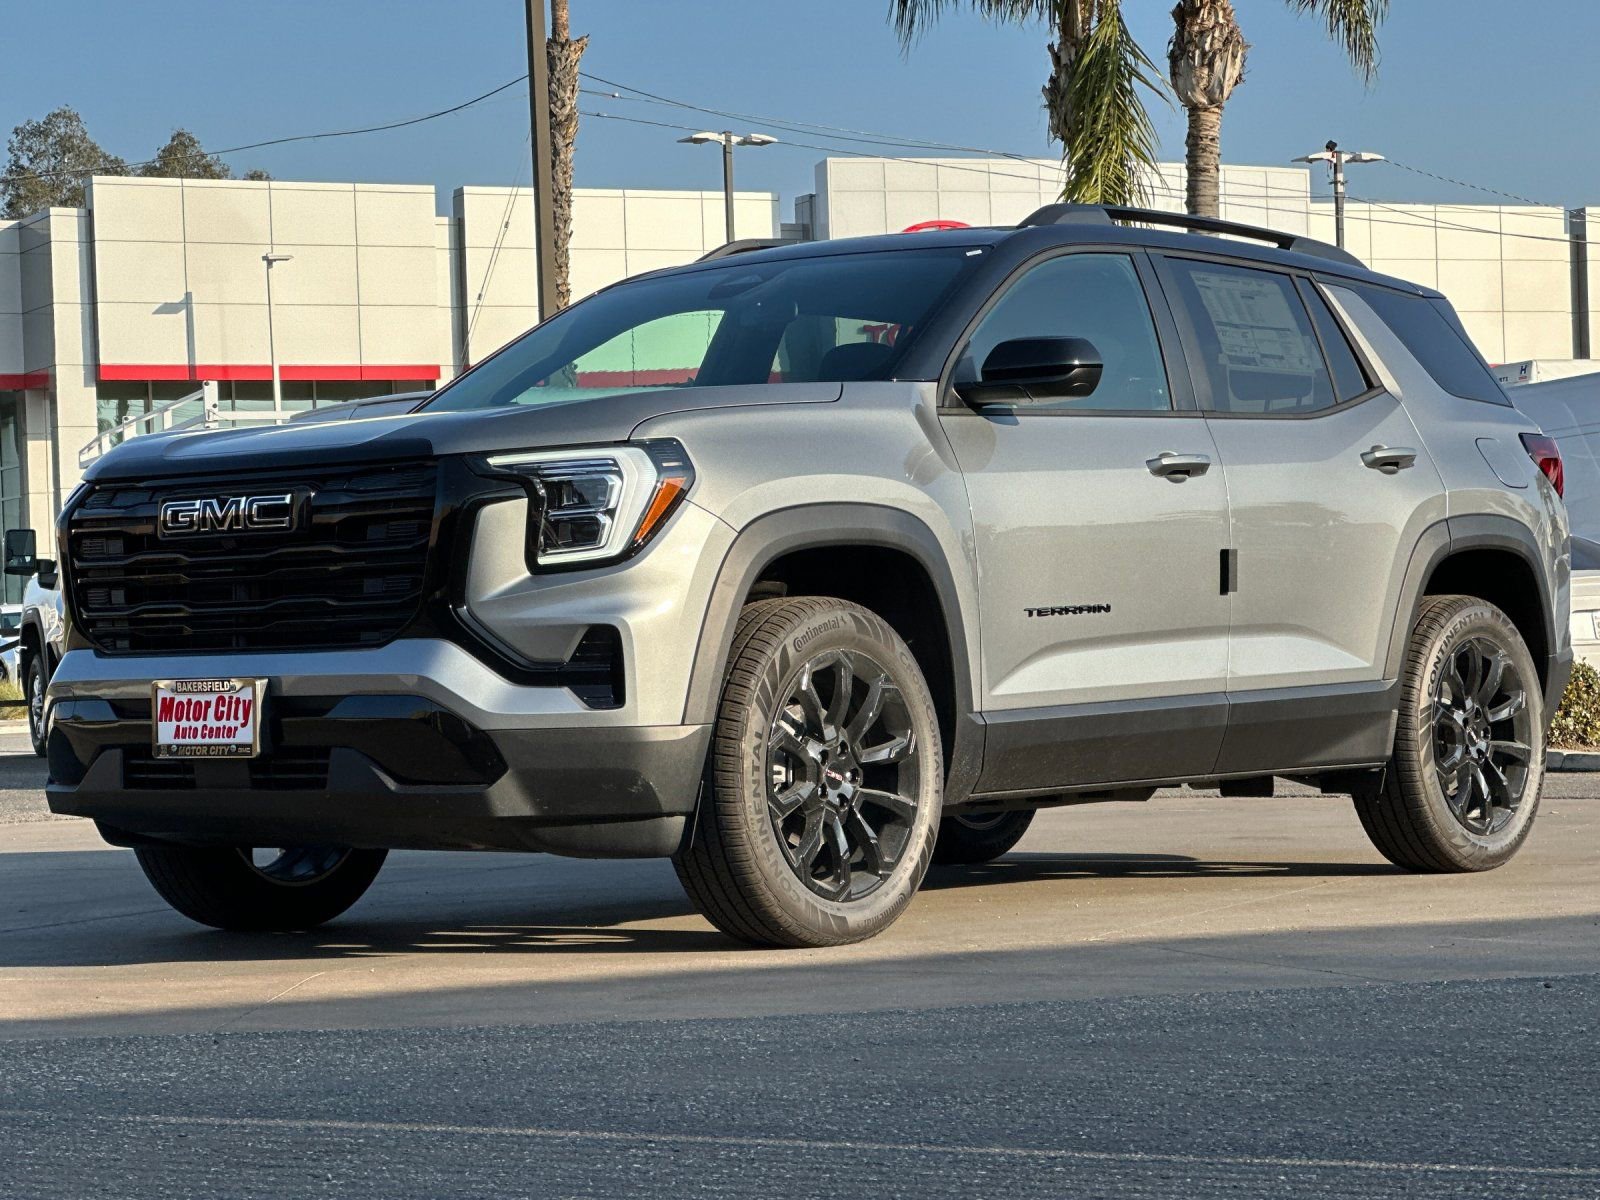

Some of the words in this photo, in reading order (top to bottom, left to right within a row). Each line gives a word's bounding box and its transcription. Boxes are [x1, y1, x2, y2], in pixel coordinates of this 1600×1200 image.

[160, 494, 292, 533] GMC
[1023, 603, 1111, 618] TERRAIN
[792, 616, 841, 653] Continental
[1427, 611, 1485, 698] CONTINENTAL
[177, 681, 230, 692] BAKERSFIELD
[159, 697, 212, 722] Motor
[214, 695, 252, 728] City
[174, 725, 199, 739] Auto
[201, 724, 238, 739] Center
[178, 745, 207, 755] MOTOR
[209, 745, 230, 755] CITY
[751, 726, 801, 902] CONTINENTAL
